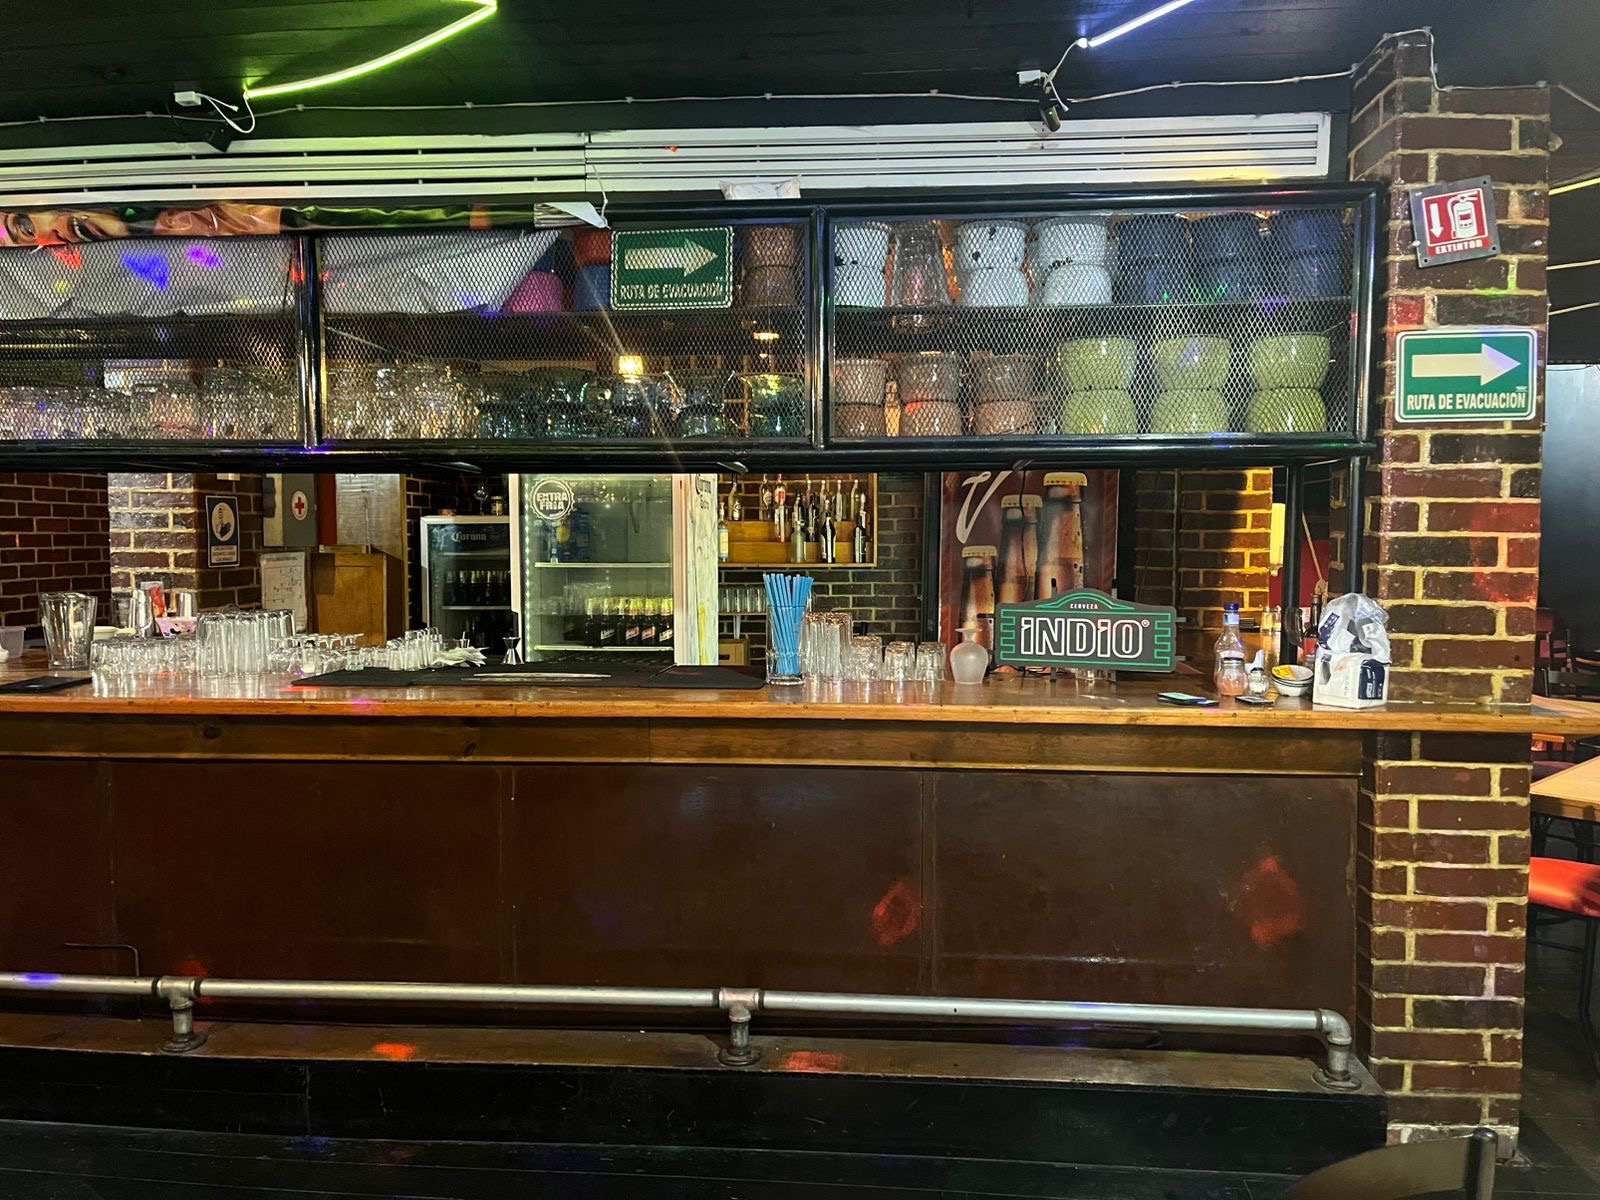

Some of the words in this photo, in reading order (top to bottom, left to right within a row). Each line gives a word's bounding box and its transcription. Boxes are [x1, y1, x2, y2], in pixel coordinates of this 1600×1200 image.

[1435, 240, 1482, 255] EXTINTOR
[620, 284, 645, 299] RUTA
[648, 284, 660, 298] DE
[1407, 394, 1435, 410] RUTA
[1439, 394, 1452, 409] DE
[1456, 393, 1525, 409] EVACUACION
[537, 492, 568, 501] EXTRA
